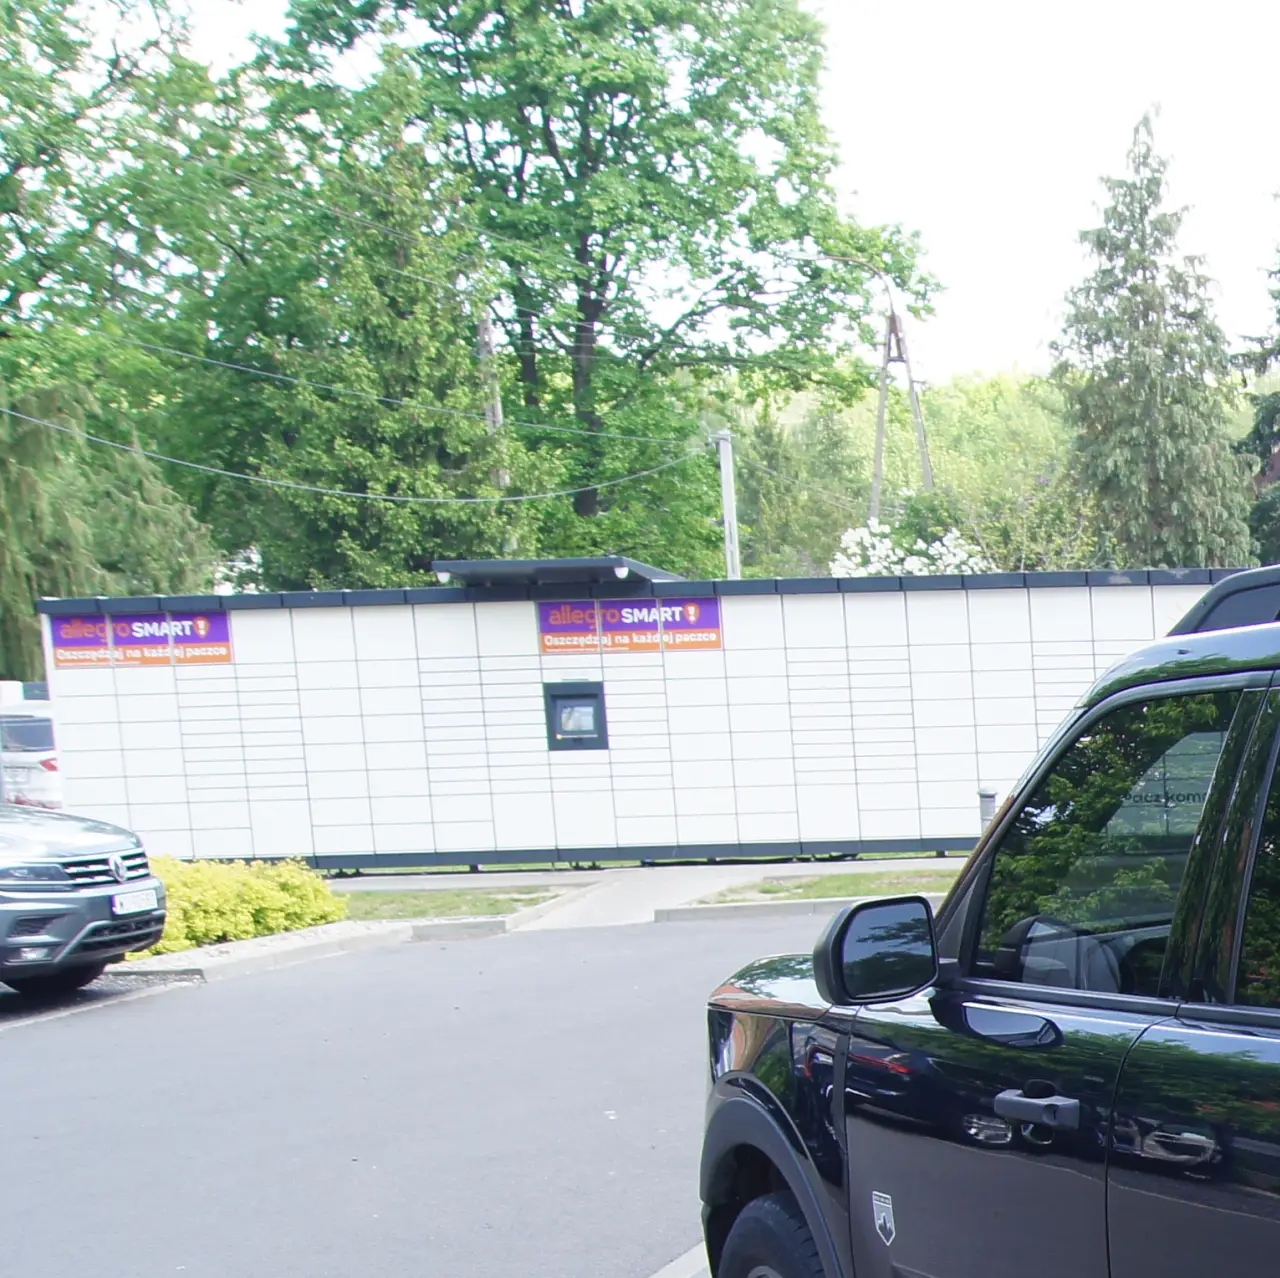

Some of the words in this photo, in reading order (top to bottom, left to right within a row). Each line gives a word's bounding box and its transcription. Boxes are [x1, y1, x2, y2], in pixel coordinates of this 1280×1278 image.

[550, 605, 619, 629] allegro
[60, 617, 130, 643] allegro
[614, 635, 630, 644] na
